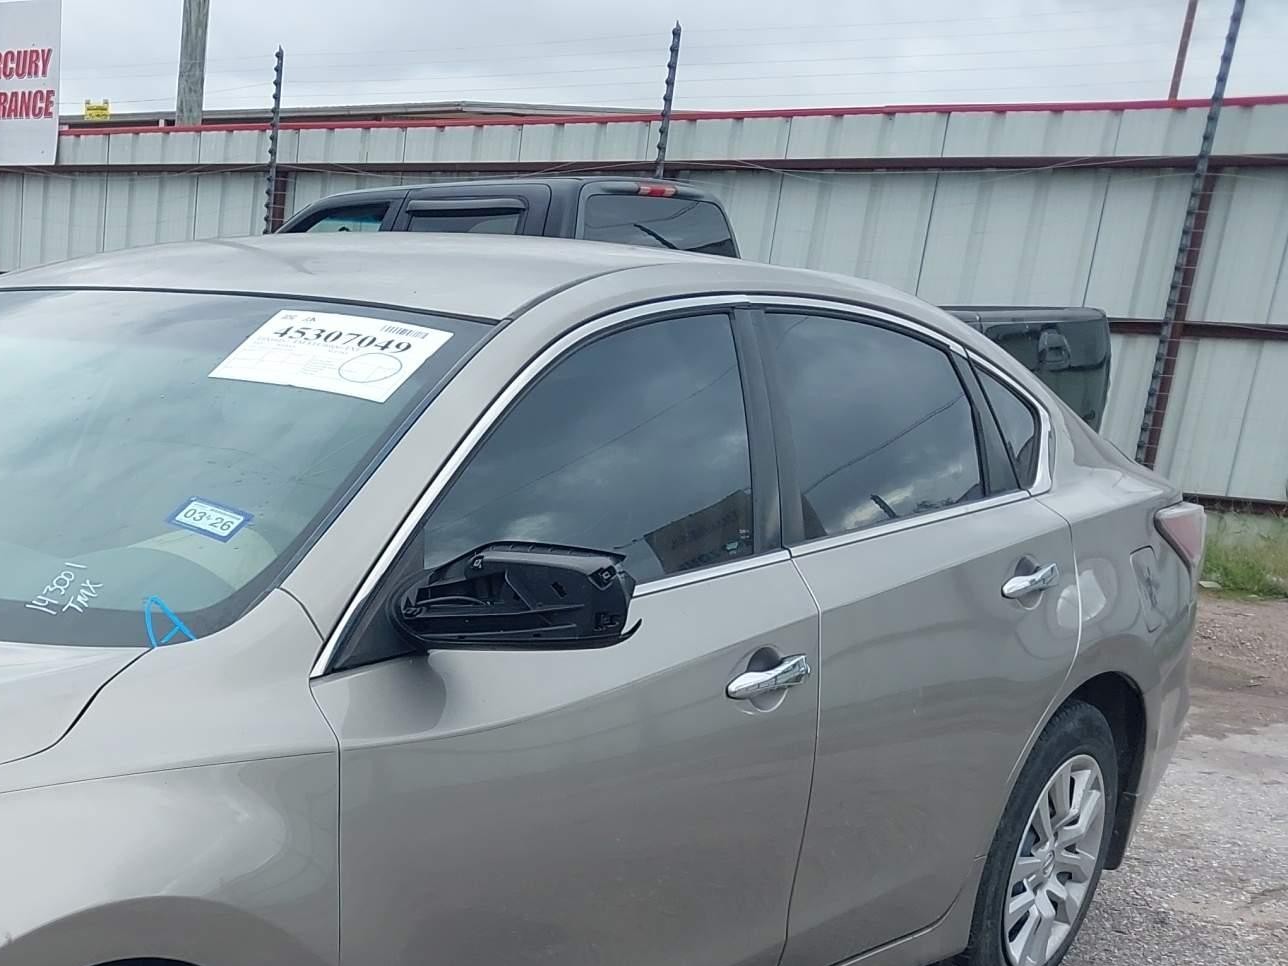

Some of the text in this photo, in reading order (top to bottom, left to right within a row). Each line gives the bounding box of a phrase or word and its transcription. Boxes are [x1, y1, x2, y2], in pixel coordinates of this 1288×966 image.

[273, 326, 412, 354] 45307049
[183, 508, 234, 531] 03 26
[62, 579, 104, 613] TMX
[144, 595, 198, 649] A
